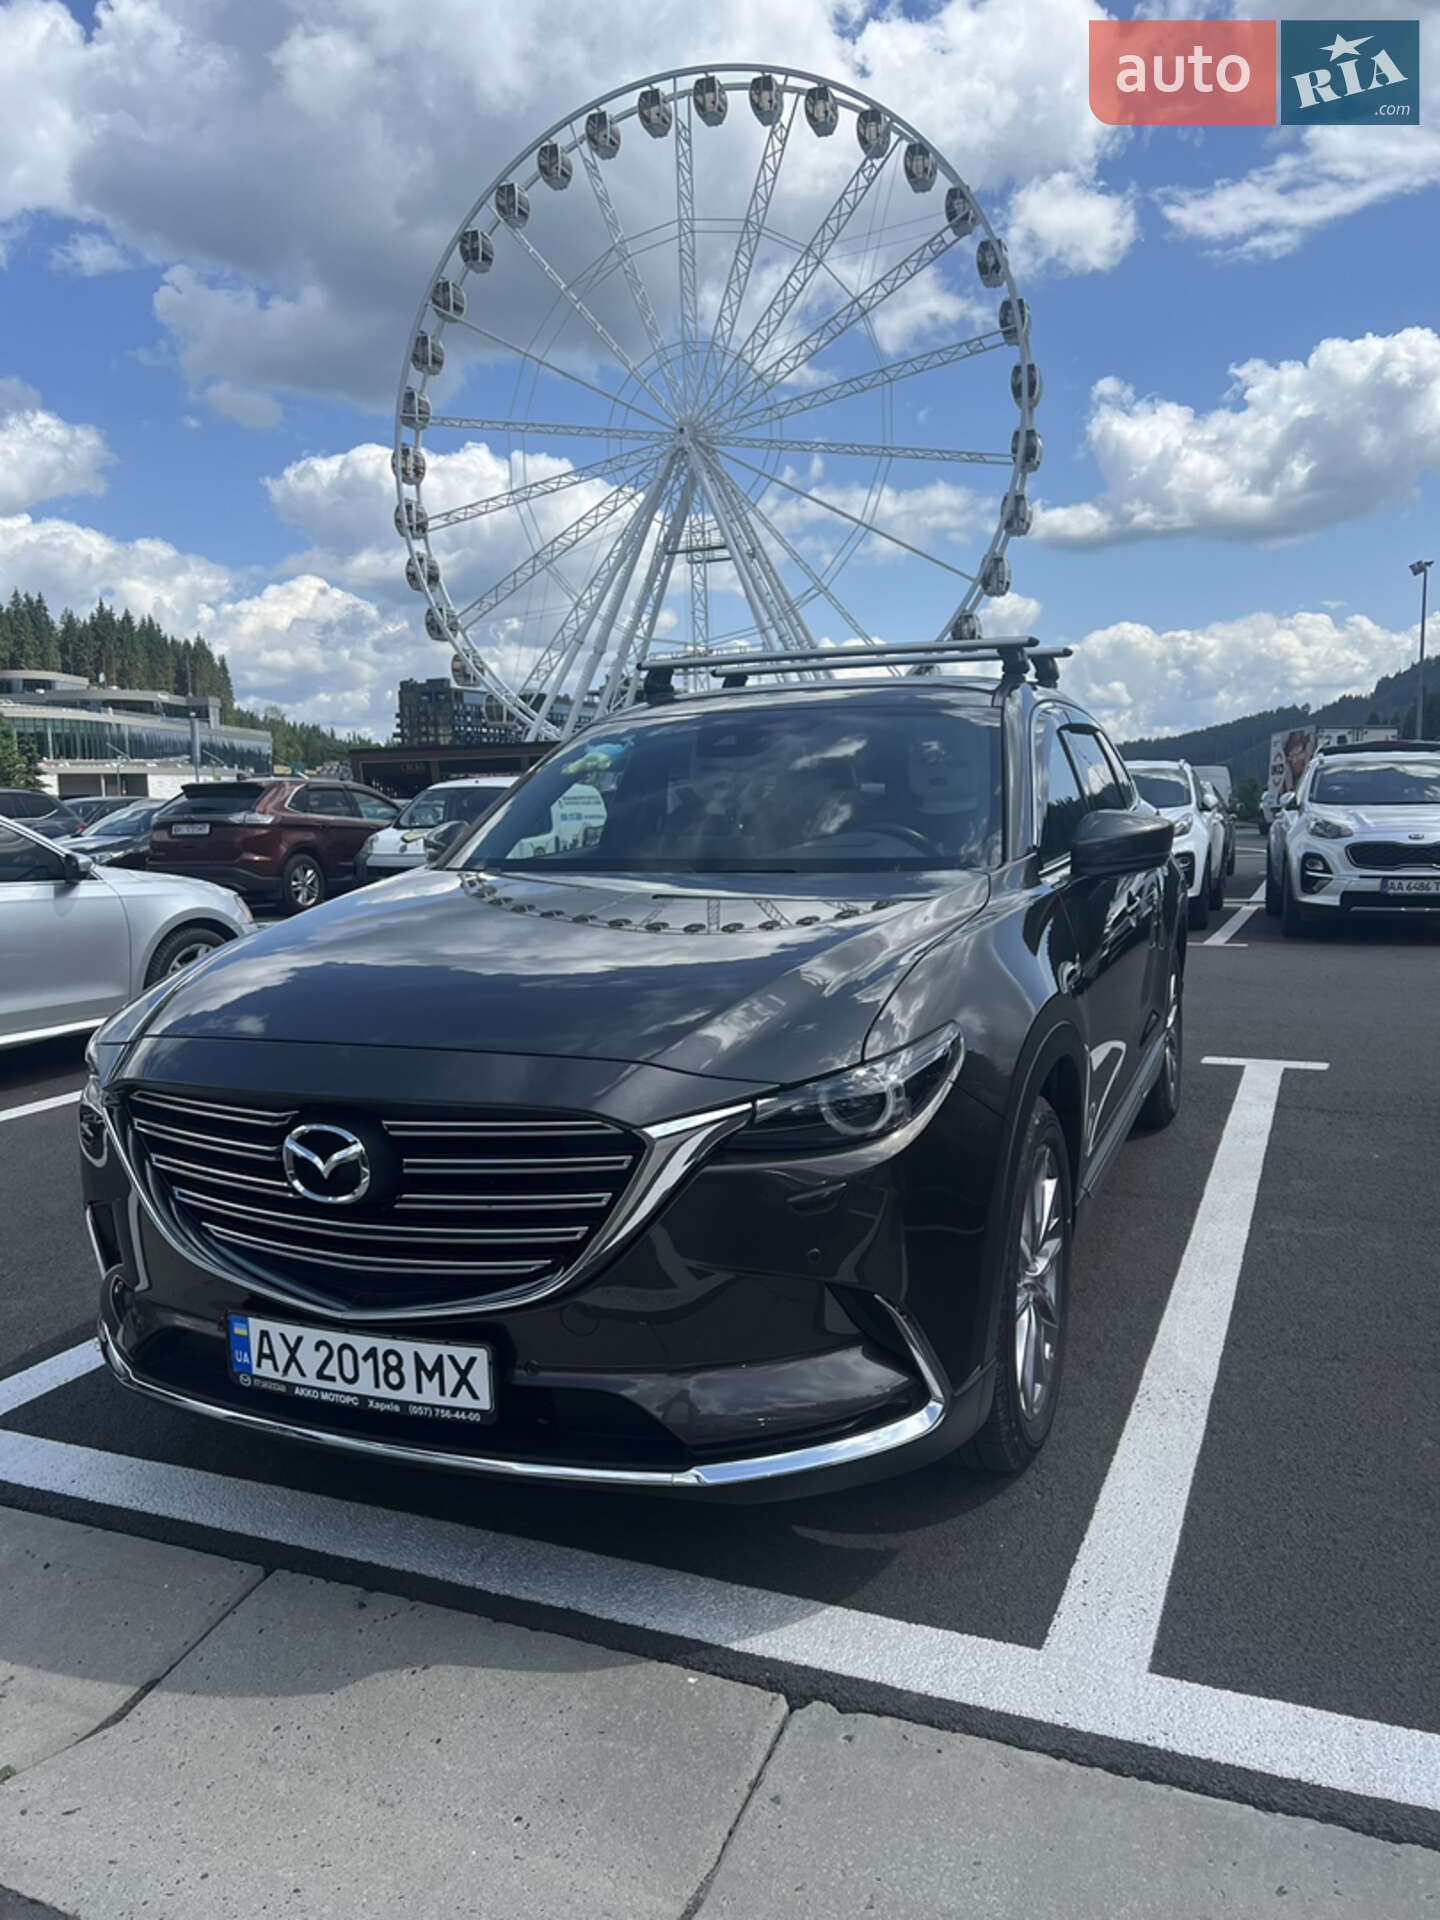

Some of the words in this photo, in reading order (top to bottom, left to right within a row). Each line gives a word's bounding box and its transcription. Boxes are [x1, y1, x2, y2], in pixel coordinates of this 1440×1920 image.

[234, 1350, 250, 1364] UA
[255, 1329, 307, 1378] AX
[314, 1339, 406, 1391] 2018
[413, 1350, 481, 1401] MX
